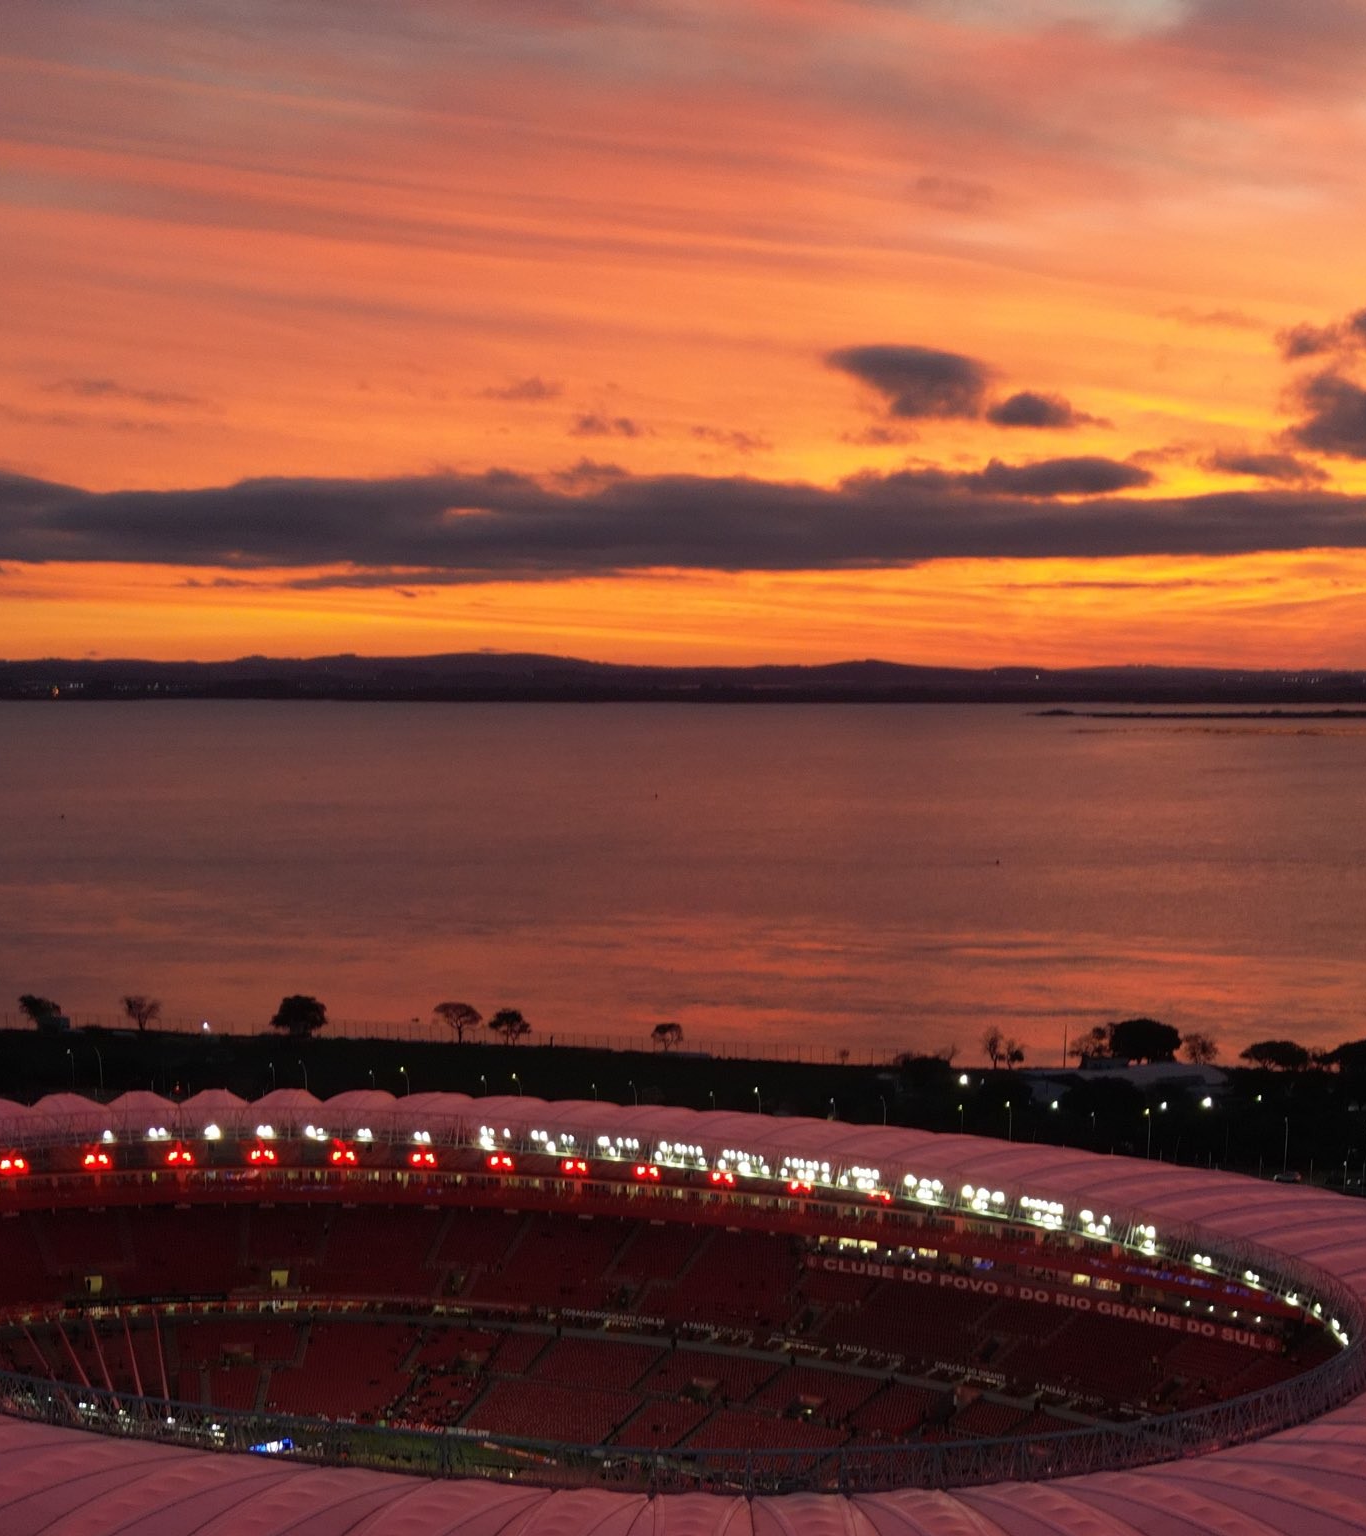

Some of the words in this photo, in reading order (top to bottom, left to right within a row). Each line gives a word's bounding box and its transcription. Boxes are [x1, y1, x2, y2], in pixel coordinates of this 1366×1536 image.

[823, 1259, 895, 1279] CLUBE
[902, 1269, 932, 1284] DO
[939, 1275, 999, 1294] POVO
[1019, 1288, 1050, 1303] DO
[1055, 1293, 1091, 1309] RIO
[1098, 1300, 1181, 1329] GRANDE
[1186, 1320, 1216, 1337] DO
[1222, 1328, 1261, 1349] SUL
